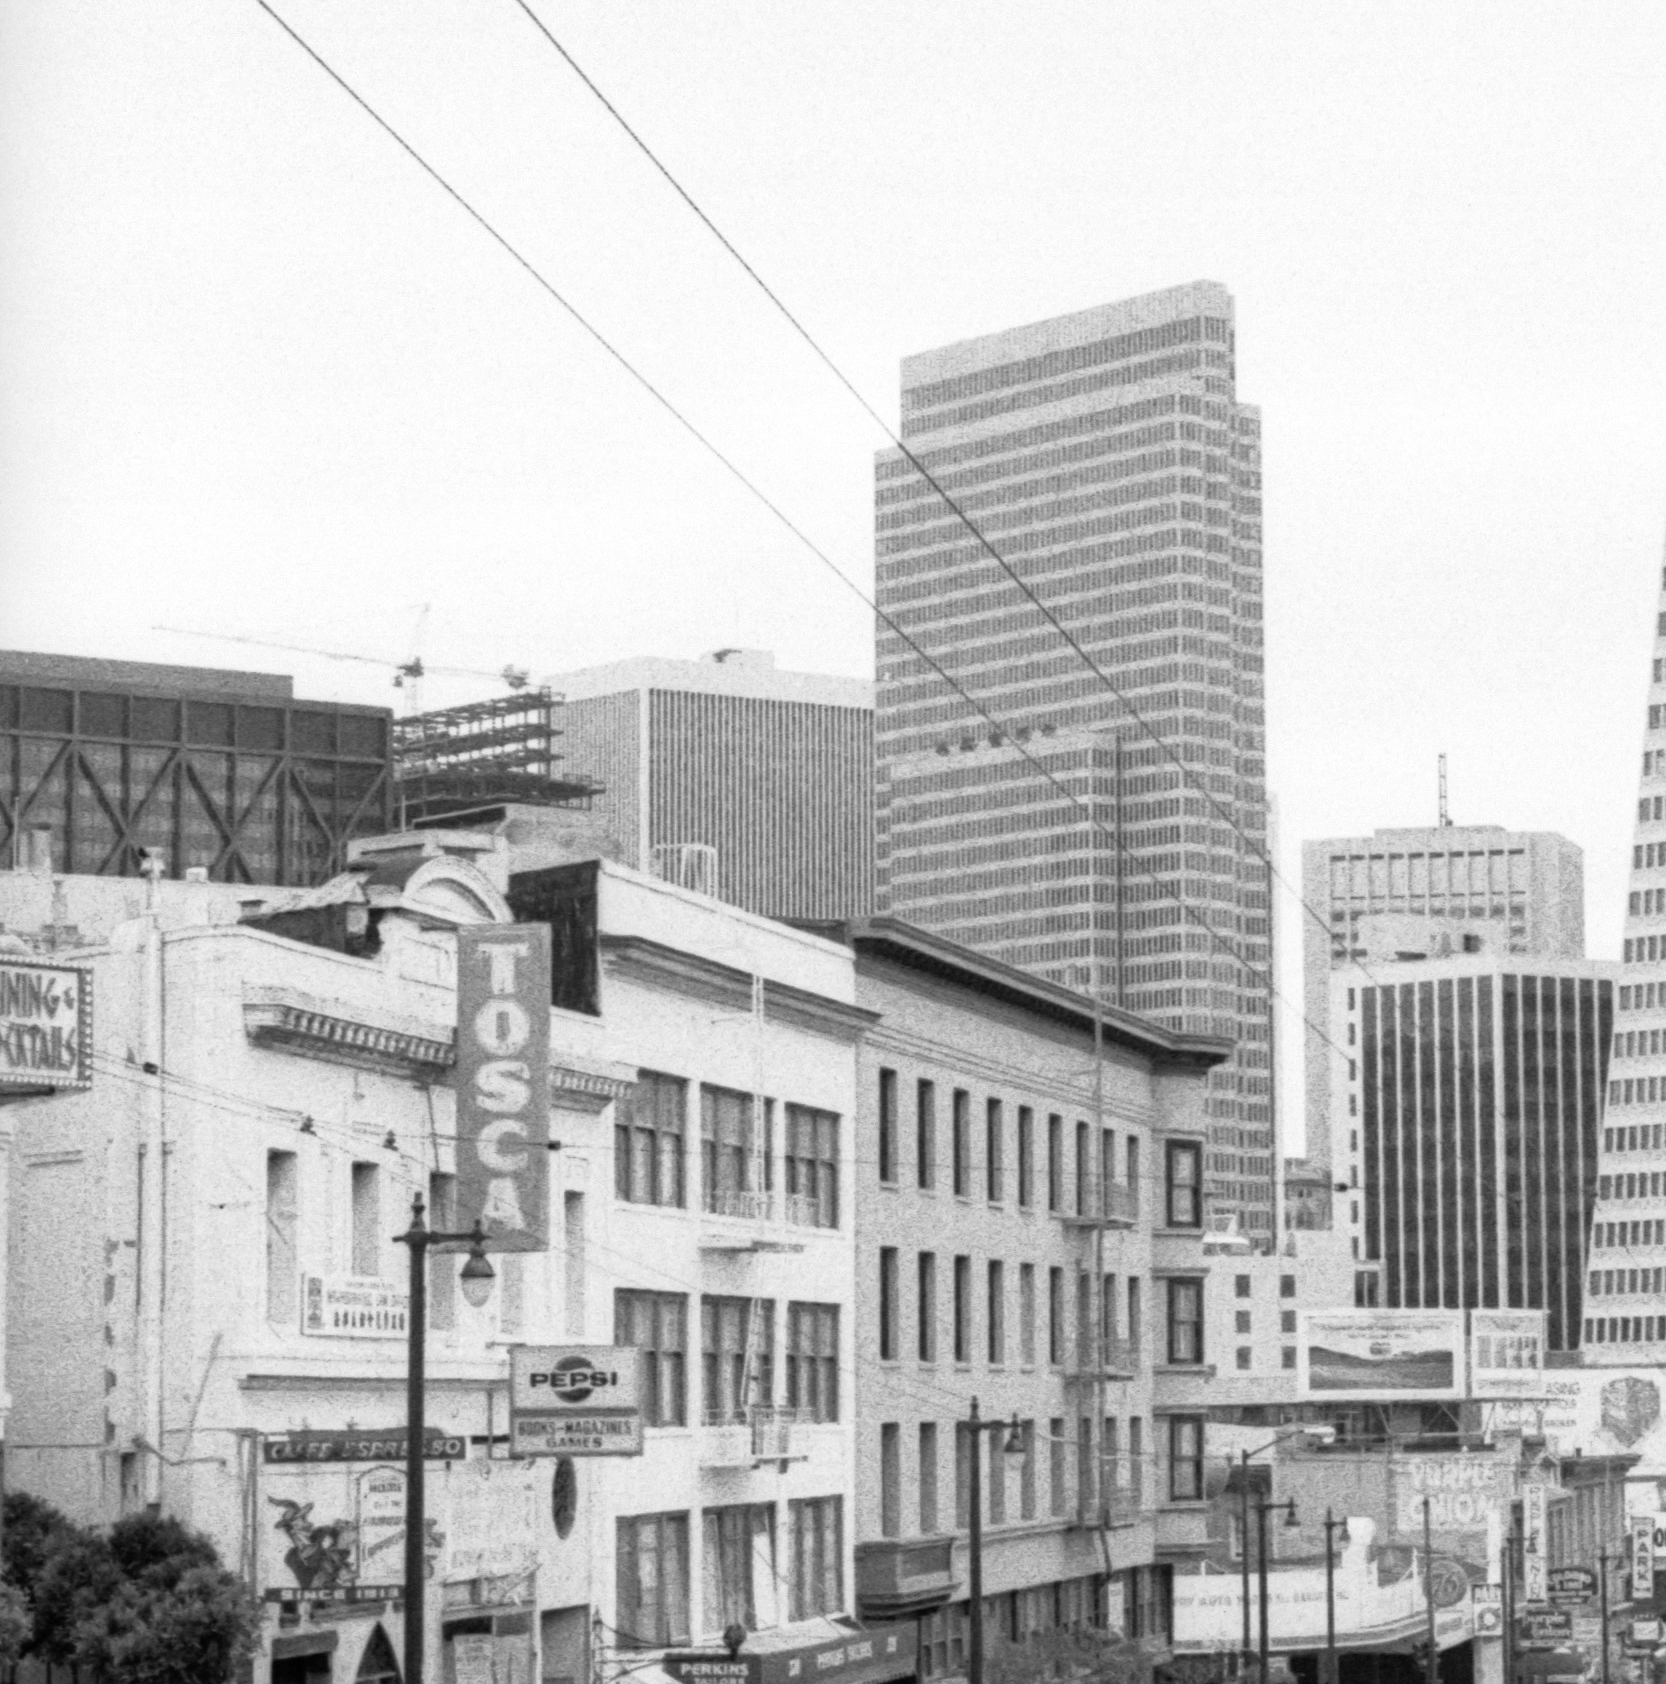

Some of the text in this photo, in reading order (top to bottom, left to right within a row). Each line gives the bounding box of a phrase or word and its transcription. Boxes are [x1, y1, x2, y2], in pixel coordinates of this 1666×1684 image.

[475, 942, 531, 1232] TOSCA
[529, 1370, 618, 1388] PEPSI
[545, 1437, 603, 1449] GAMES
[1636, 1528, 1651, 1582] PARK
[280, 1588, 346, 1602] SINCE
[680, 1662, 749, 1677] PERKINS
